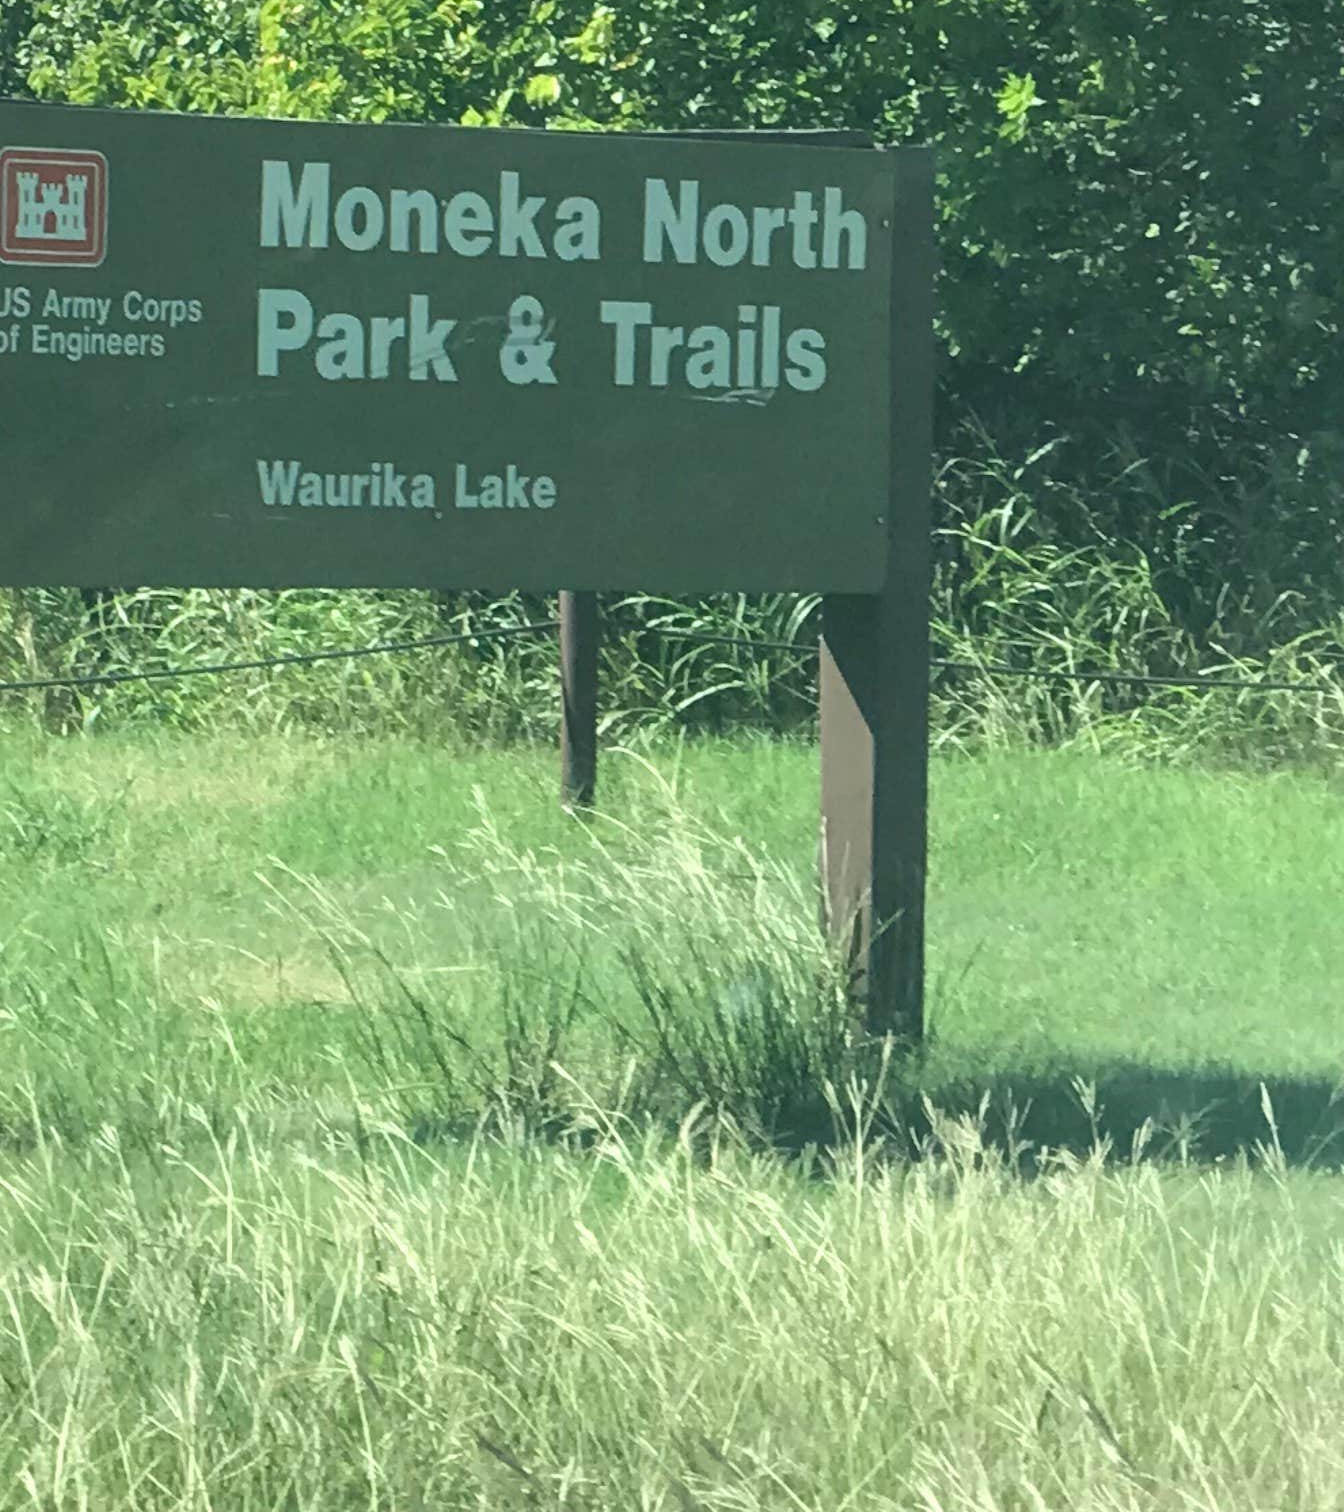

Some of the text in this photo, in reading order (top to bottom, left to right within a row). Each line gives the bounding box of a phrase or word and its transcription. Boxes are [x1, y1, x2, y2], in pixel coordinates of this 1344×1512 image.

[260, 159, 867, 270] Moneka North
[42, 288, 111, 326] Army
[122, 290, 202, 328] Corps
[31, 323, 166, 361] Engineers
[257, 288, 827, 392] Park & Trails
[256, 459, 557, 509] Waurika Lake
